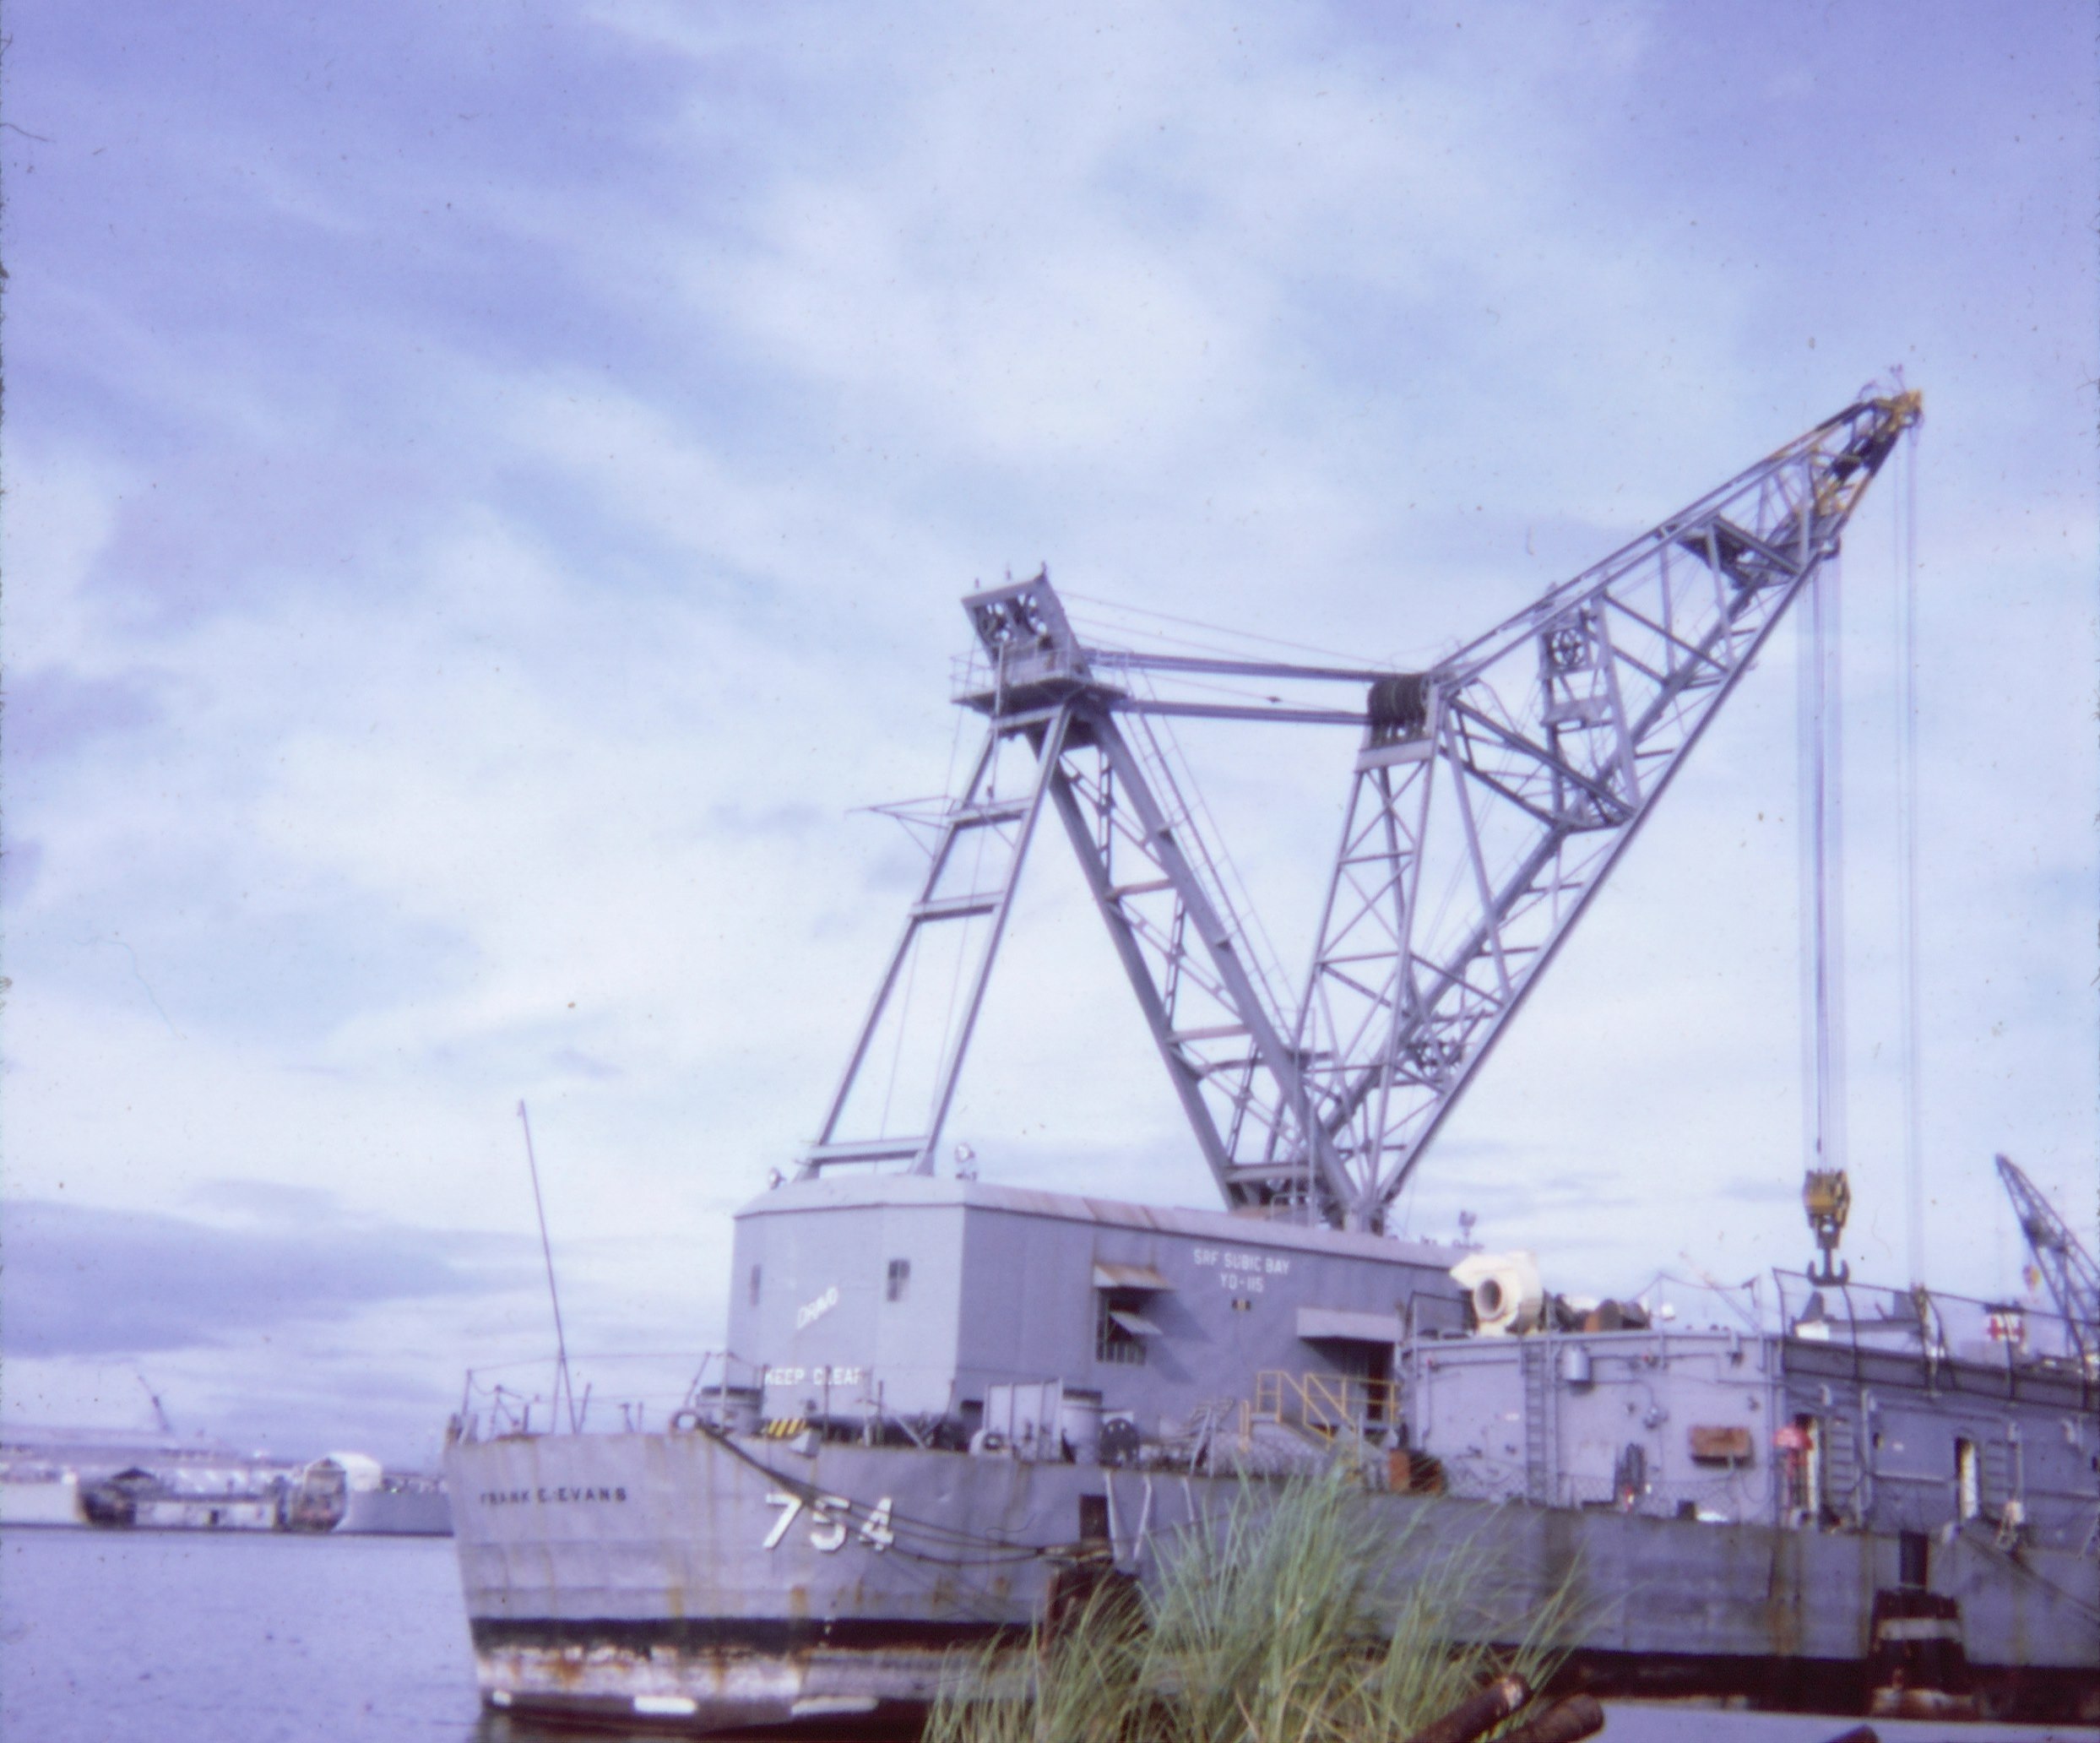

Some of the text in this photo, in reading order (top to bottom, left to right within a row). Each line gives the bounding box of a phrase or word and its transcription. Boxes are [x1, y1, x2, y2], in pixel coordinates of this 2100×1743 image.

[1193, 1248, 1290, 1275] SRF SUBIC BAY
[763, 1366, 864, 1386] KEEP CEA
[557, 1487, 627, 1502] EVANS
[762, 1493, 894, 1552] 754
